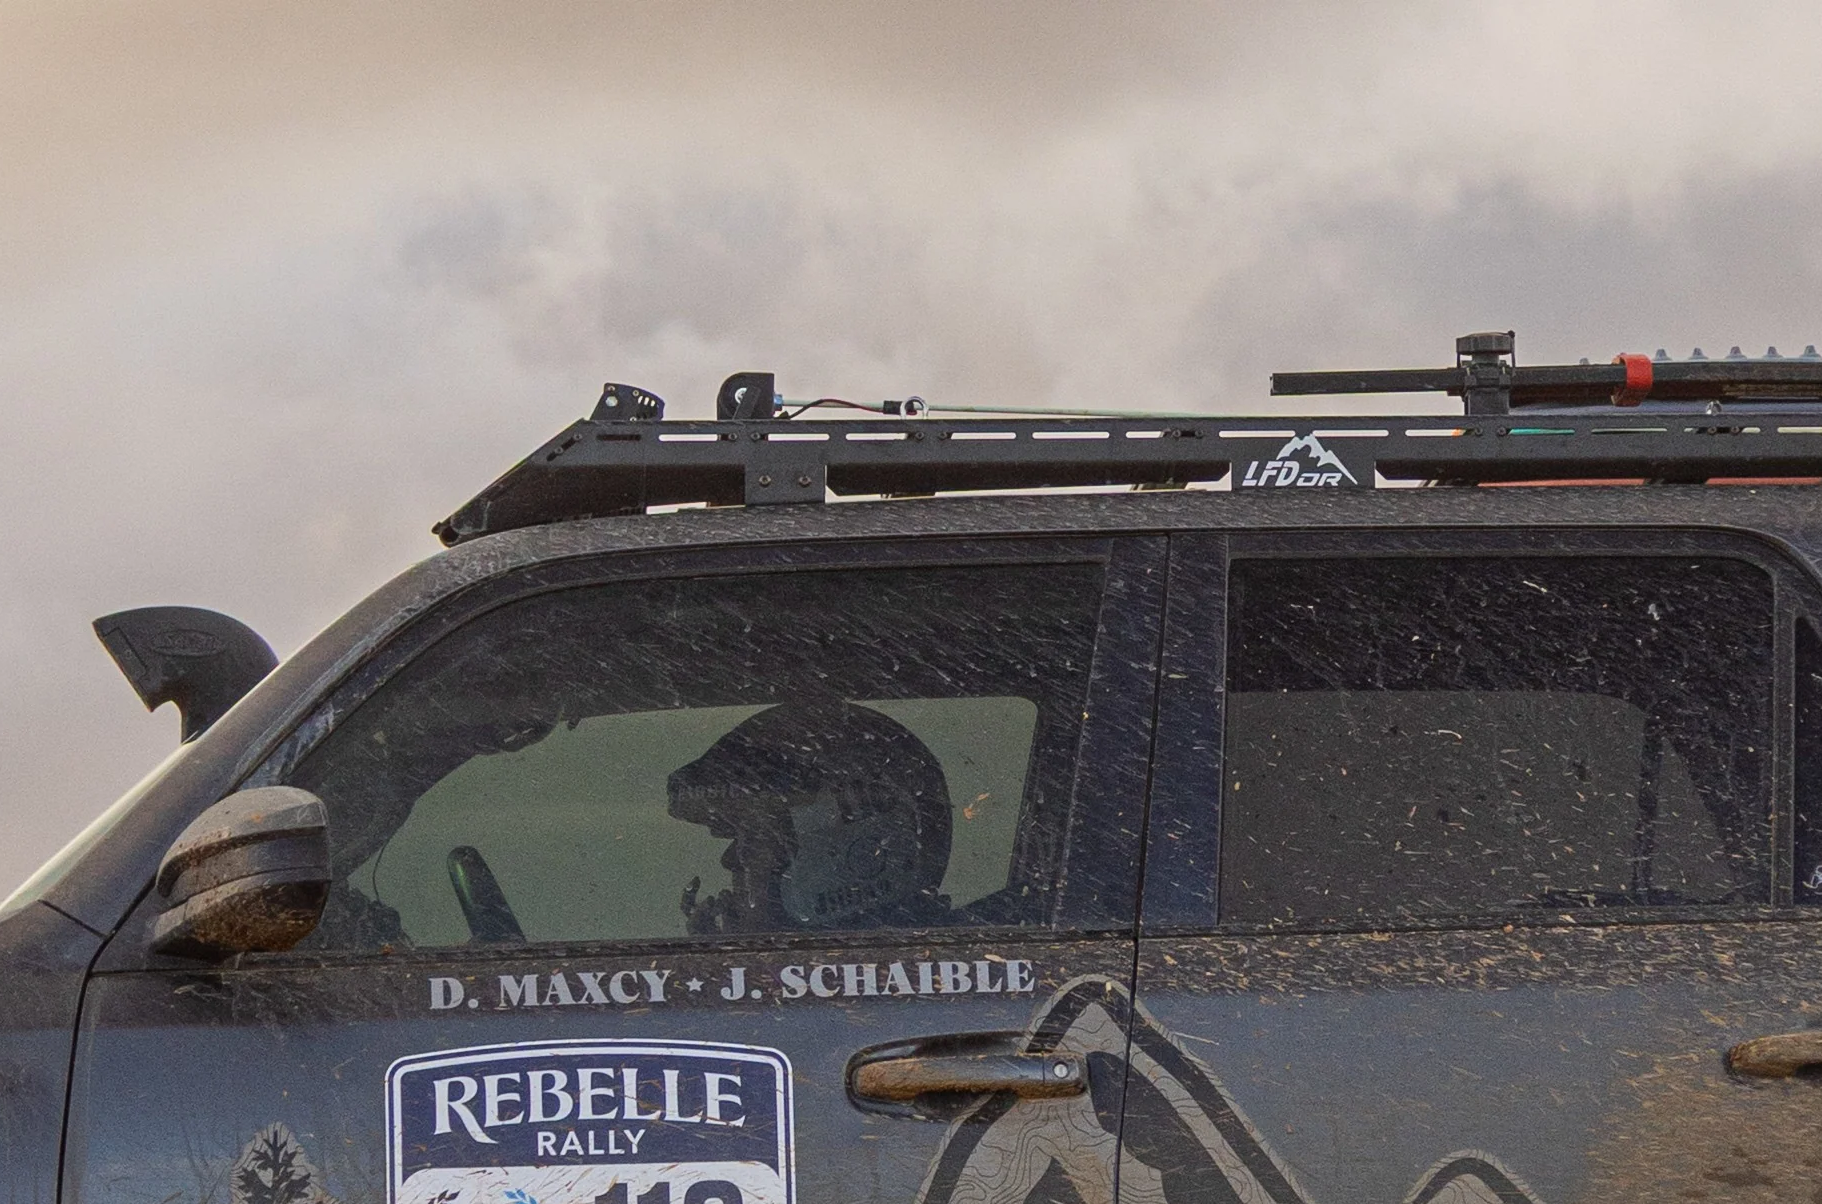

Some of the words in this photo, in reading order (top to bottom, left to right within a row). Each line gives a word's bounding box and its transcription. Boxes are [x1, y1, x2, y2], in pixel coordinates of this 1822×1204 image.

[428, 976, 478, 1010] D.
[497, 968, 672, 1008] MAXCY
[720, 967, 763, 1001] J.
[781, 959, 1037, 999] SCHAIBLE
[432, 1067, 746, 1144] REBELLE
[536, 1129, 647, 1157] RALLY
